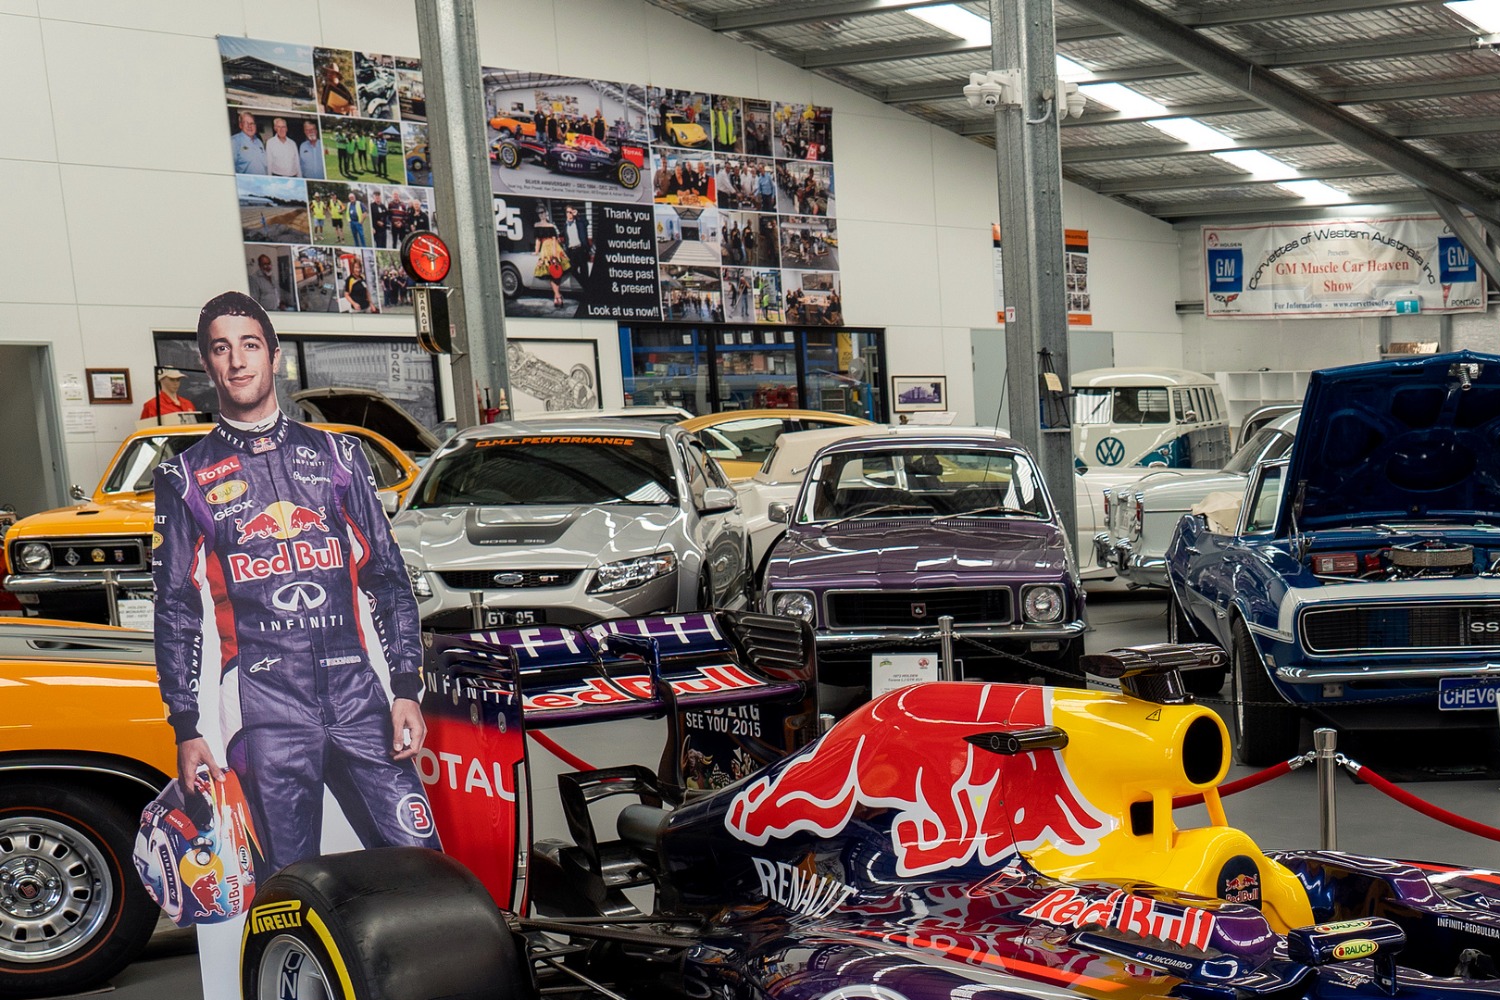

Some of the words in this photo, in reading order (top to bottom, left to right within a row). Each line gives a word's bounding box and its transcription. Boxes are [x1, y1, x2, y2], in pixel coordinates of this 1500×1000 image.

[623, 149, 643, 157] TOTAL
[603, 207, 633, 221] Thank
[633, 210, 650, 222] you
[615, 224, 624, 234] to
[626, 226, 641, 235] our
[607, 238, 651, 250] wonderful
[605, 253, 655, 265] volunteers
[1248, 239, 1299, 290] Corvettes
[1299, 229, 1312, 245] of
[1313, 228, 1371, 241] Western
[1371, 230, 1424, 267] Australia
[1447, 248, 1469, 267] GM
[608, 267, 633, 279] those
[634, 270, 655, 281] past
[1215, 257, 1235, 277] GM
[1275, 263, 1297, 275] GM
[1300, 261, 1339, 274] Muscle
[1342, 260, 1365, 273] Car
[1367, 259, 1410, 272] Heaven
[611, 282, 619, 293] &
[620, 284, 654, 295] present
[1323, 279, 1354, 292] Show
[1274, 301, 1285, 310] For
[1286, 300, 1323, 310] Information
[1450, 299, 1481, 307] PONTIAC
[418, 292, 428, 332] GARAGE
[587, 305, 610, 316] Look
[611, 306, 622, 316] at
[623, 308, 634, 317] us
[635, 307, 659, 317] now!!
[520, 436, 635, 446] PERFORMANCE
[292, 458, 326, 467] INFINITI
[197, 460, 241, 482] TOTAL
[213, 499, 254, 522] GEOX
[227, 542, 292, 583] Red
[294, 536, 344, 571] Bull
[260, 614, 344, 632] INFINITI
[487, 612, 506, 625] GT
[1470, 621, 1499, 633] SS
[615, 664, 768, 699] Bull
[685, 712, 704, 730] SEE
[706, 715, 729, 733] YOU
[732, 718, 761, 738] 2015
[412, 800, 429, 830] 3
[225, 874, 240, 898] Bull
[751, 856, 860, 919] RENAULT
[1225, 893, 1243, 903] Red
[1242, 888, 1259, 901] Bull
[226, 897, 240, 918] Red
[251, 899, 303, 935] PIRELLI
[1018, 886, 1125, 929] Red
[1117, 894, 1217, 953] Bull
[1345, 943, 1373, 956] RAUCH
[1154, 955, 1193, 970] RICCIARDO
